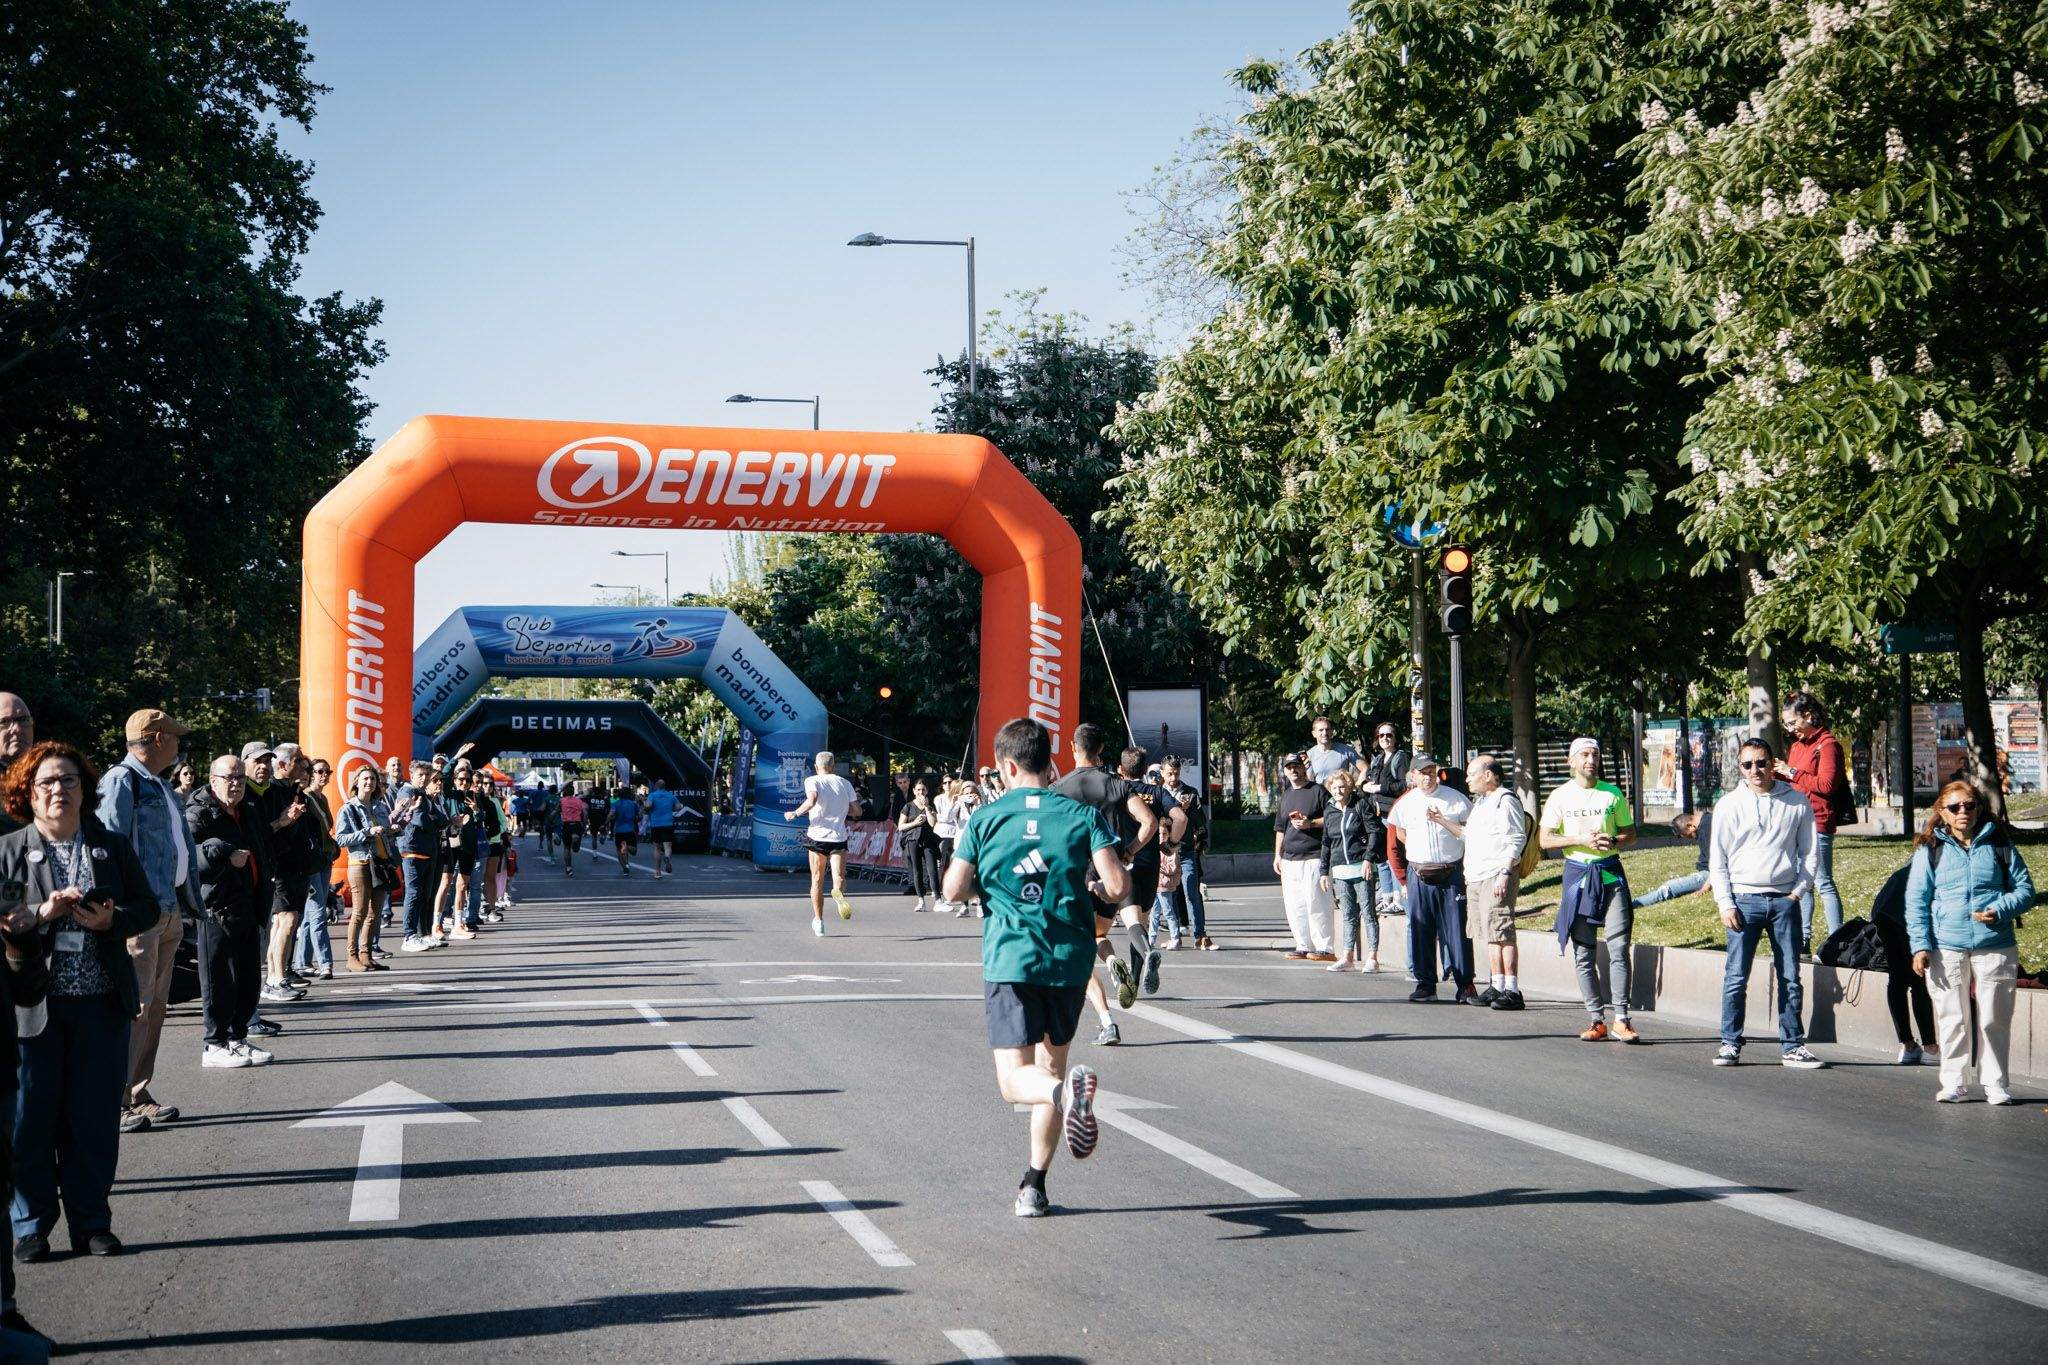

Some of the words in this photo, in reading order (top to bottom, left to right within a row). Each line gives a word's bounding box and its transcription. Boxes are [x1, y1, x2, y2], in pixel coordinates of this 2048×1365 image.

[645, 448, 897, 509] ENERVIT
[531, 510, 672, 527] Science
[682, 515, 717, 528] in
[727, 516, 886, 531] Nutrition
[506, 616, 551, 631] Club
[515, 630, 612, 656] Deportivo
[346, 588, 385, 754] ENERVIT
[412, 638, 466, 701] mberos
[505, 655, 555, 664] bomberos
[560, 655, 573, 664] de
[576, 655, 613, 664] madrid
[715, 664, 775, 722] madrid
[731, 647, 799, 721] bomberos
[511, 715, 612, 730] DECIMAS
[673, 789, 707, 797] ECIMAS
